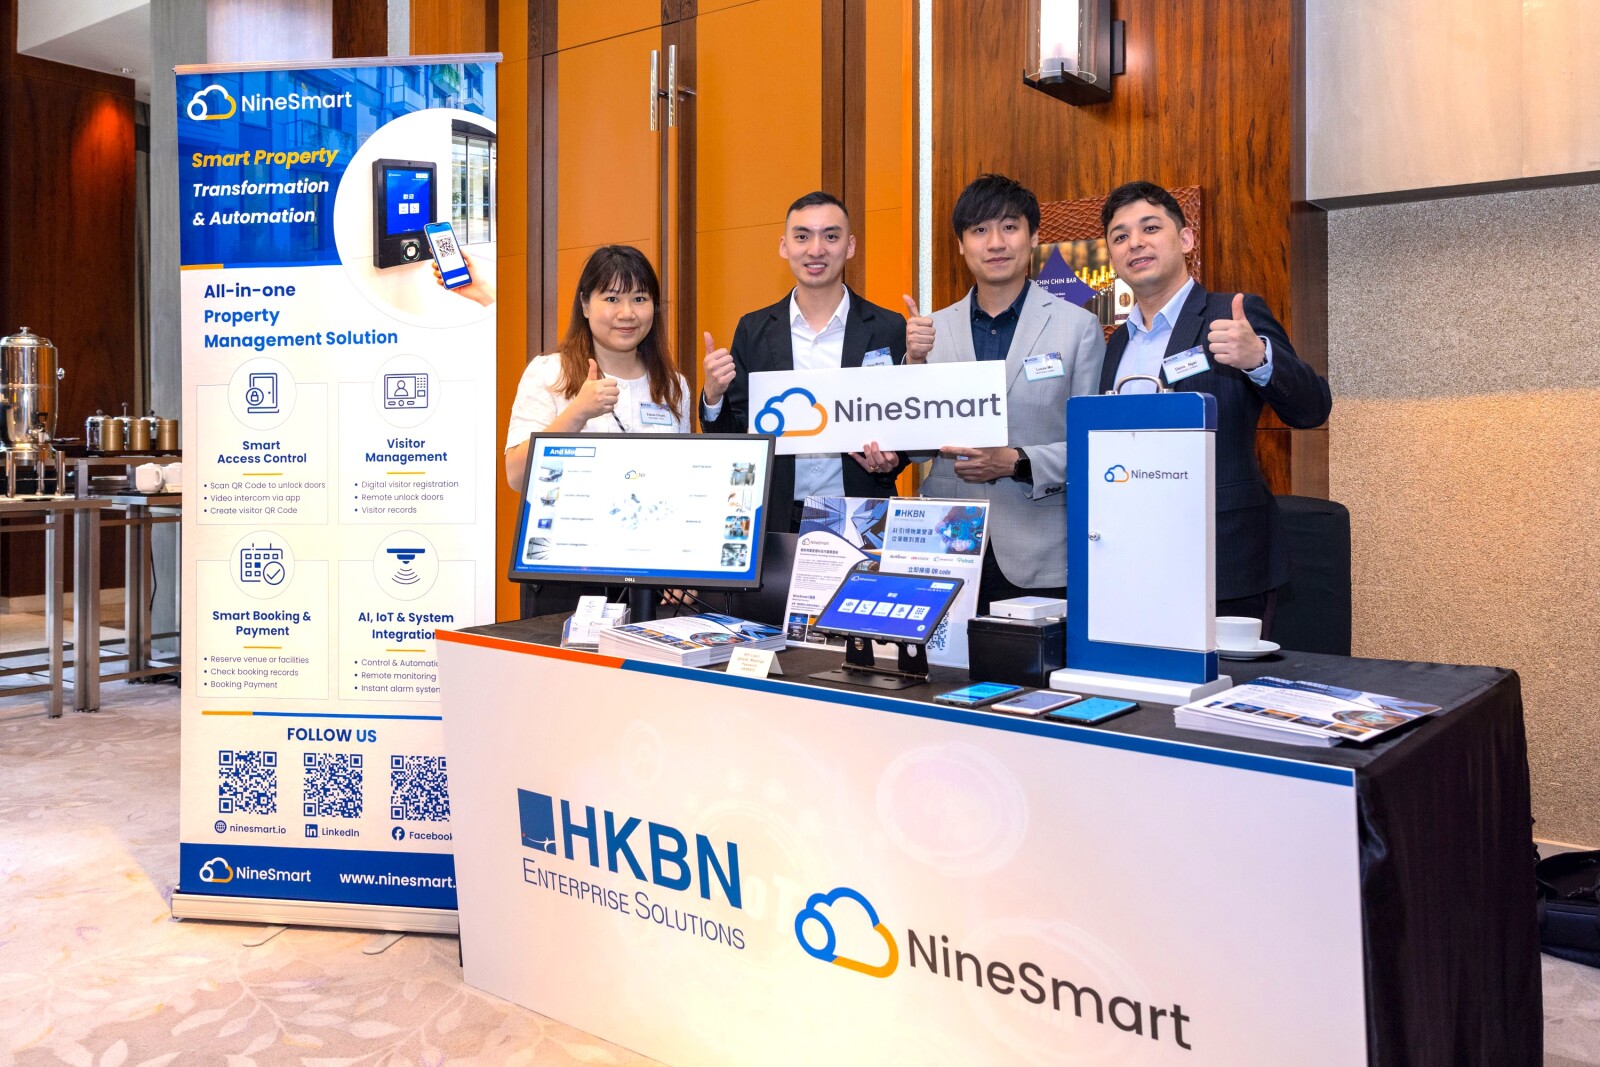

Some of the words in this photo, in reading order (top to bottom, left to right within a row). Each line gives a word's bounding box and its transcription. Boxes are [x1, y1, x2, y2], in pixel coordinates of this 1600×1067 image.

[241, 91, 353, 112] NineSmart
[192, 150, 250, 168] Smart
[254, 147, 339, 169] Property
[193, 178, 329, 197] Transformation
[192, 212, 206, 226] &
[209, 208, 316, 226] Automation
[204, 282, 296, 299] All-in-one
[204, 307, 280, 327] Property
[204, 331, 322, 352] Management
[325, 329, 398, 346] Solution
[834, 392, 1001, 423] NineSmart
[242, 440, 281, 451] Smart
[386, 437, 426, 449] Visitor
[217, 453, 261, 464] Access
[263, 452, 307, 464] Control
[365, 451, 448, 465] Management
[1131, 469, 1189, 480] NineSmart
[231, 481, 243, 489] QR
[244, 481, 266, 489] Code
[278, 481, 302, 489] unlock
[303, 481, 326, 489] doors
[361, 480, 387, 490] Digital
[388, 480, 411, 488] visitor
[412, 480, 459, 490] registration
[210, 494, 233, 502] Video
[234, 494, 271, 502] intercom
[285, 495, 301, 503] app
[361, 493, 393, 501] Remote
[394, 493, 419, 501] unlock
[421, 493, 444, 501] doors
[238, 506, 262, 514] visitor
[277, 506, 298, 514] Code
[361, 506, 386, 514] Visitor
[387, 506, 417, 514] records
[901, 509, 926, 518] HKBN
[212, 610, 250, 621] Smart
[253, 610, 300, 624] Booking
[302, 611, 312, 622] &
[358, 612, 373, 624] AI,
[376, 612, 394, 622] IoT
[396, 612, 406, 622] &
[408, 612, 454, 625] System
[235, 625, 290, 638] Payment
[278, 655, 310, 664] facilities
[361, 659, 391, 667] Control
[391, 659, 398, 667] &
[210, 668, 236, 676] Check
[237, 668, 269, 678] booking
[393, 672, 437, 682] monitoring
[210, 681, 242, 690] Booking
[243, 681, 278, 690] Payment
[361, 684, 389, 692] Instant
[390, 685, 414, 693] alarm
[287, 727, 352, 742] FOLLOW
[355, 728, 377, 743] US
[229, 823, 287, 834] ninesmart.io
[321, 827, 360, 837] LinkedIn
[560, 798, 742, 910] HKBN
[236, 866, 312, 882] NineSmart
[522, 857, 630, 915] ENTERPRISE
[634, 891, 746, 950] SOLUTIONS
[907, 928, 1192, 1051] NineSmart
